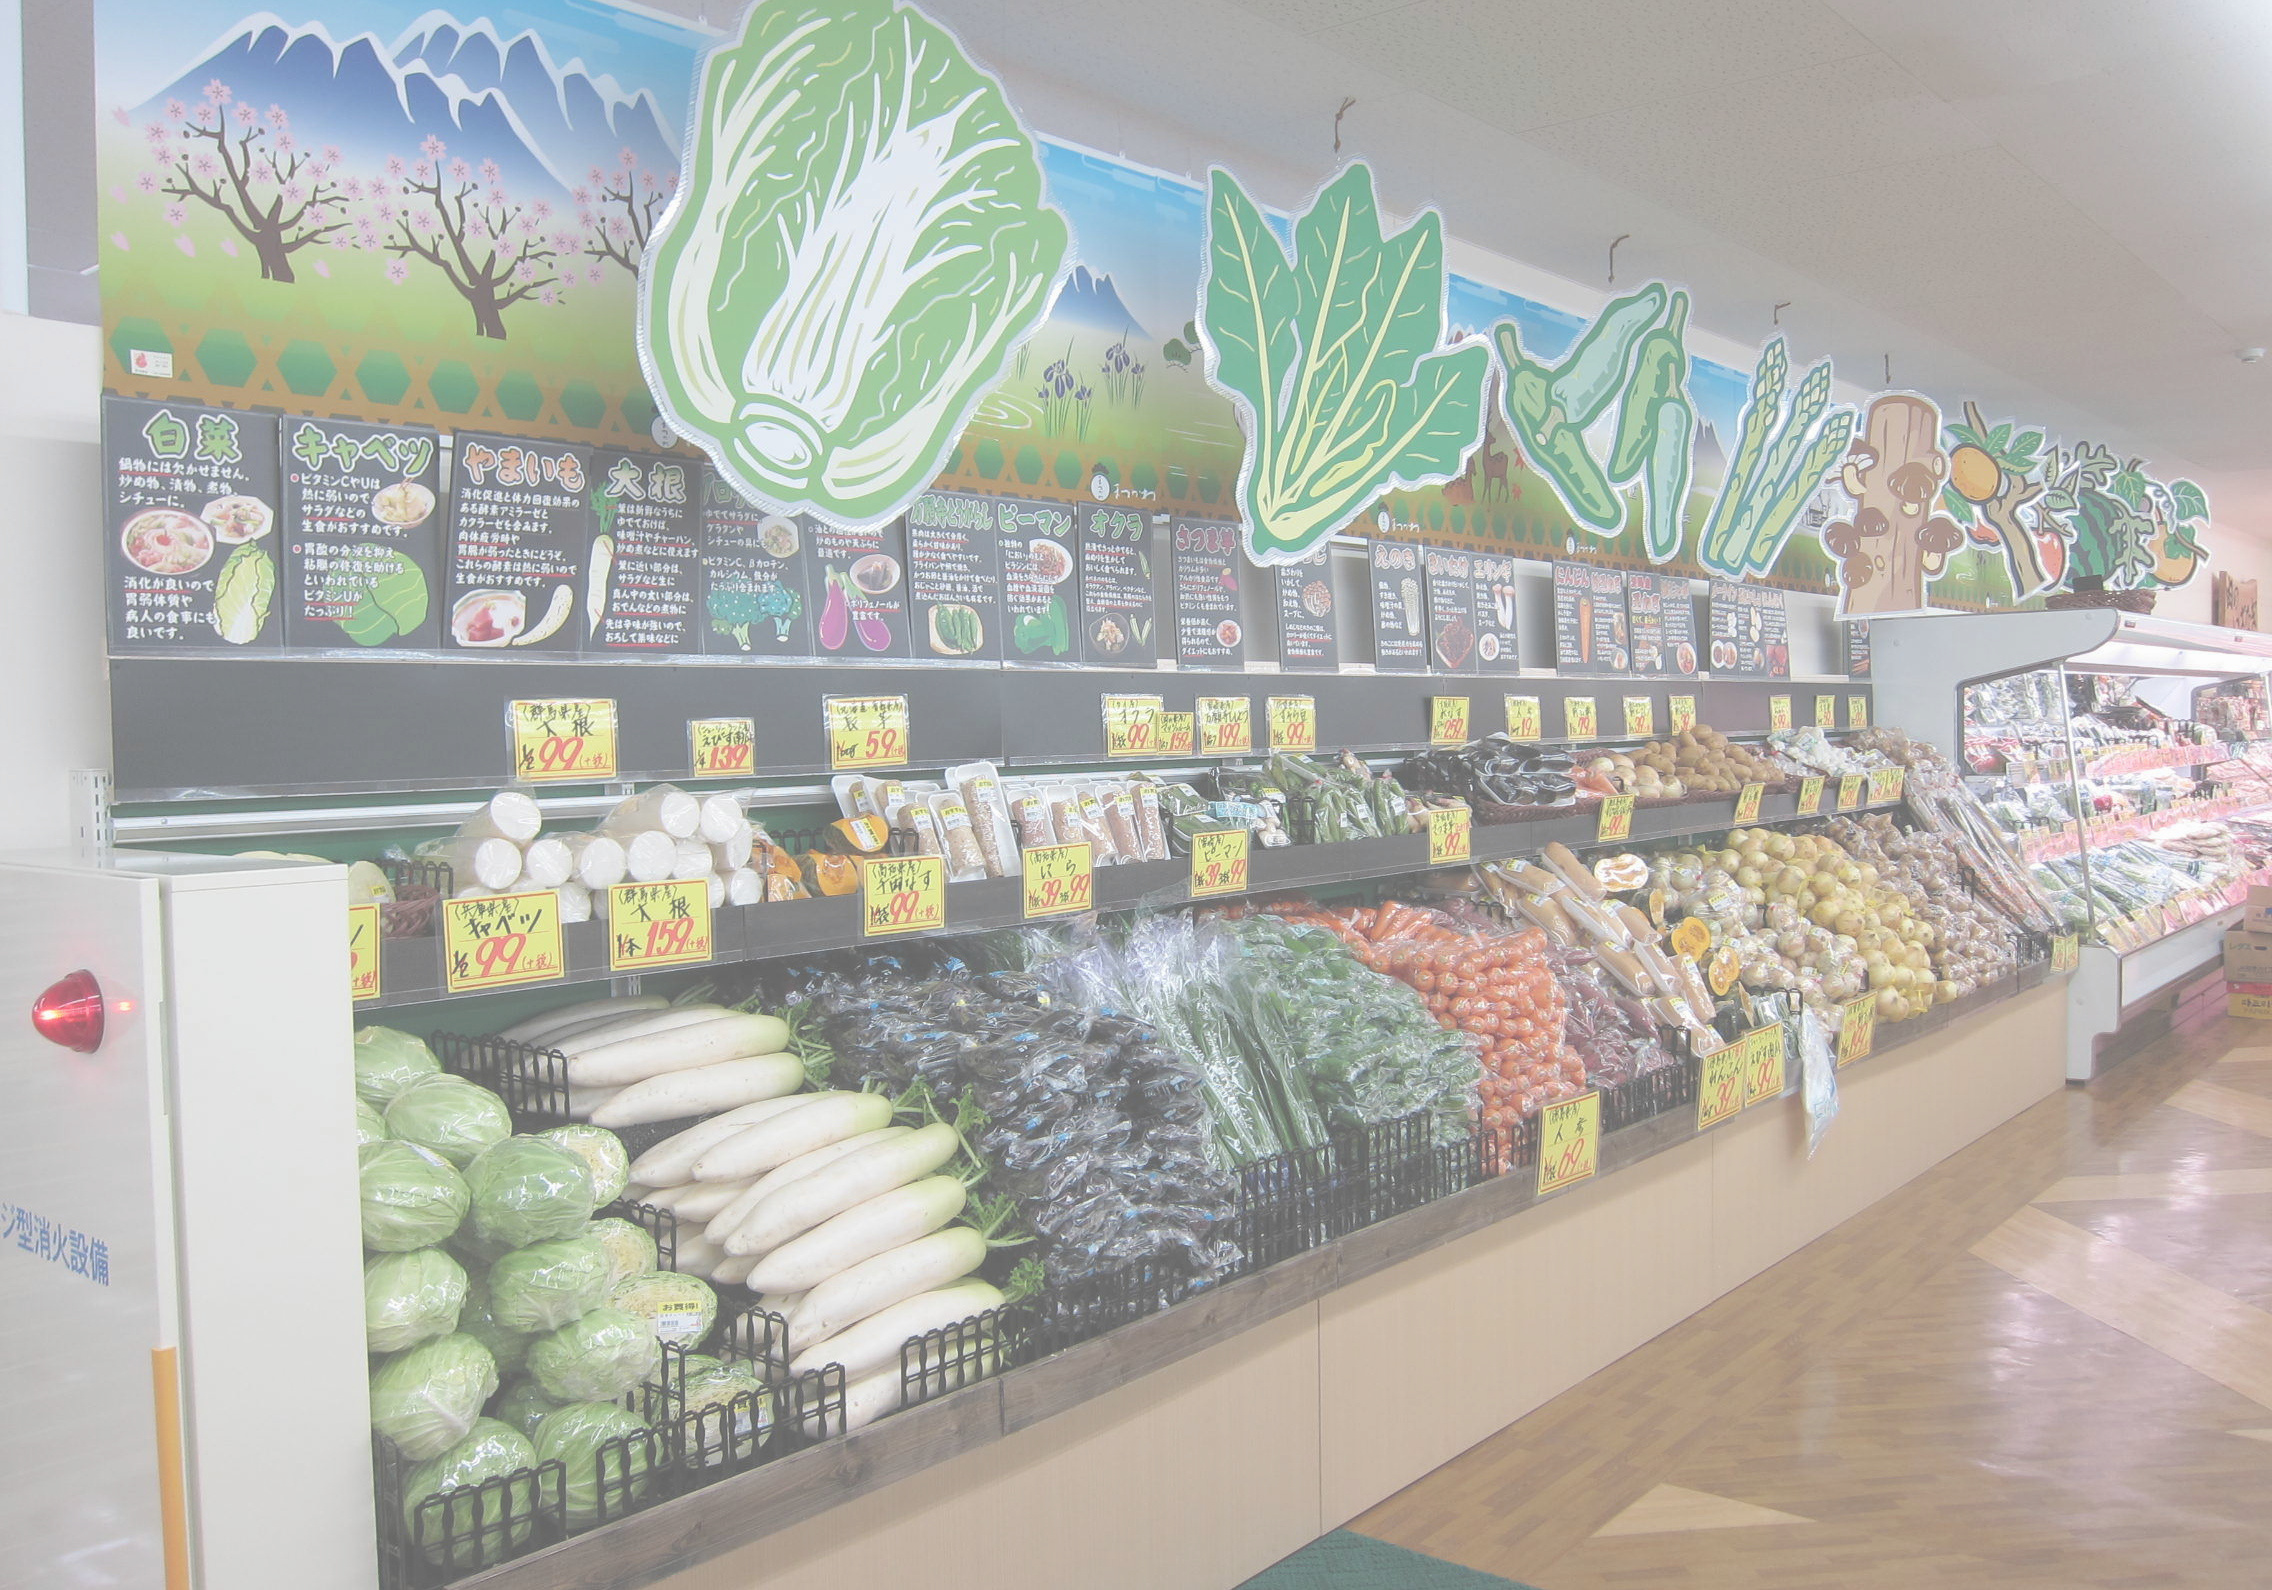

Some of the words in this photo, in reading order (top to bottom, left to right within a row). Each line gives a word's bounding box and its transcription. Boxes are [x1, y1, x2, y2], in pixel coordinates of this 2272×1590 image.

[143, 410, 242, 464] 白菜
[292, 422, 433, 477] キャベツ
[118, 457, 250, 481] 鍋物には欠かせません。
[464, 443, 585, 493] やまいも
[604, 458, 686, 503] 大根
[120, 491, 184, 508] シチューに。
[302, 504, 366, 518] サラダなどの
[302, 520, 408, 538] 生食がおすすめです。
[998, 503, 1071, 537] ピーマン
[1090, 509, 1143, 541] オクラ
[1176, 524, 1236, 556] さつま芋
[124, 576, 214, 591] 消化が良いので
[304, 574, 379, 588] といわれている
[455, 573, 547, 588] 生食がおすすめです。
[126, 593, 193, 608] 胃弱体質や
[304, 590, 363, 602] ビタミンUが
[126, 610, 218, 625] 病人の食事にも
[127, 625, 185, 640] 良いです。
[536, 717, 595, 737] 大根
[1127, 723, 1149, 749] 99
[1218, 722, 1240, 746] 199
[1287, 722, 1305, 746] 99
[539, 736, 584, 771] 99
[710, 744, 749, 770] 139
[865, 729, 897, 759] 59
[1204, 840, 1243, 862] ピーマン
[1445, 832, 1460, 855] 99
[1041, 859, 1076, 879] にら
[1205, 863, 1221, 887] 39
[1231, 858, 1247, 883] 99
[619, 885, 677, 905] (群馬県産)
[1040, 879, 1062, 907] 39
[1070, 874, 1091, 903] 99
[630, 896, 691, 922] 大根
[890, 890, 920, 925] 99
[463, 909, 542, 939] キャベツ
[644, 917, 695, 957] 159
[475, 933, 527, 977] 99
[1758, 1057, 1774, 1095] 99
[1715, 1077, 1736, 1114] 39
[1554, 1117, 1587, 1144] 人参
[1558, 1138, 1584, 1179] 69
